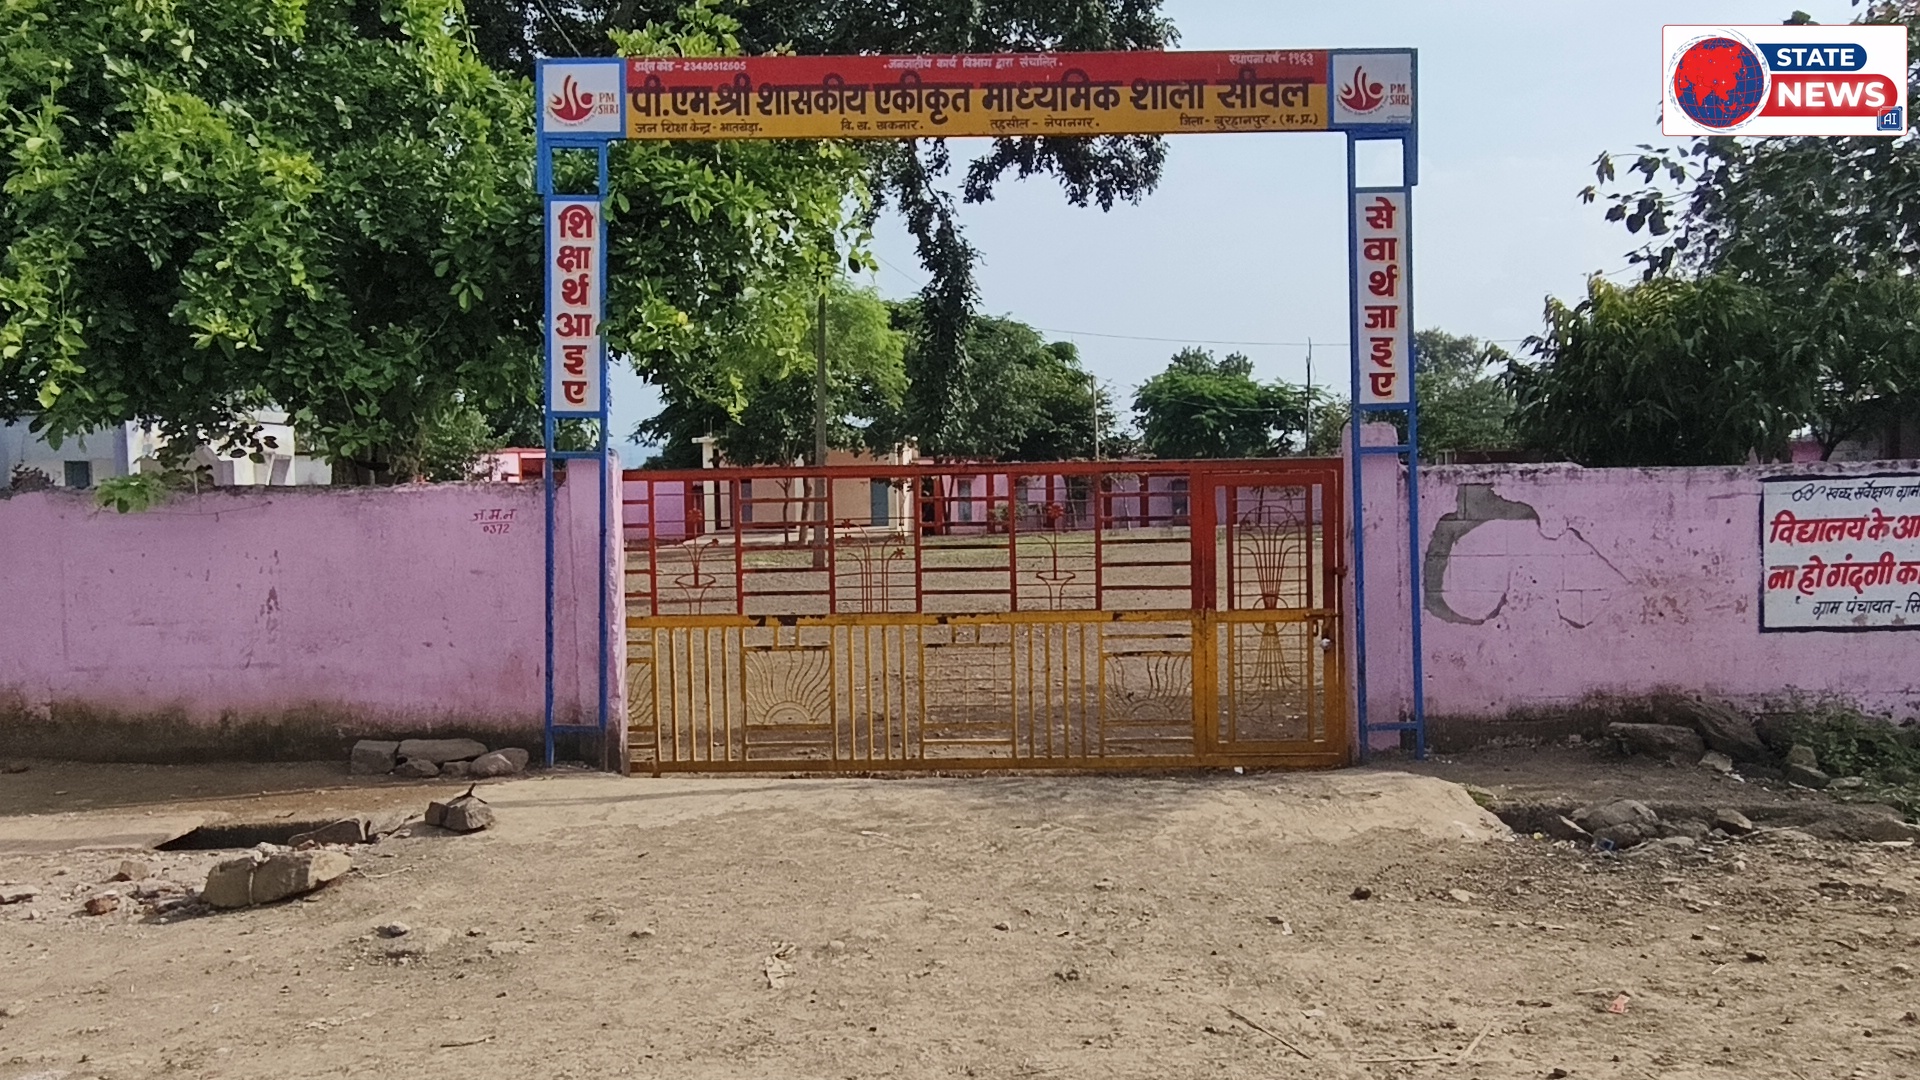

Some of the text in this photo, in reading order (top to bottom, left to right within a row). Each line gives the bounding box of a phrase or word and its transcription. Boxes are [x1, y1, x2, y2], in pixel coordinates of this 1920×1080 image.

[936, 54, 958, 68] कार्य
[962, 55, 992, 68] विभाग
[995, 56, 1014, 69] द्वारा
[1229, 54, 1265, 65] स्थापना
[756, 73, 870, 115] शासकीय
[873, 69, 973, 125] एकीकृत
[980, 68, 1122, 112] माध्यमिक
[1129, 76, 1207, 110] शाला
[1215, 66, 1315, 109] सीवल
[1390, 83, 1406, 94] PM
[598, 92, 615, 103] PM
[1389, 94, 1410, 106] SHRI
[598, 104, 619, 115] SHRI
[635, 123, 657, 133] जन
[660, 119, 688, 134] शिक्षा
[990, 115, 1030, 132] तहसील
[1826, 480, 1920, 503] स्वच्छ सर्वेक्षण ग्राम
[483, 523, 510, 535] 0372
[1769, 507, 1920, 544] विद्यालय के आ
[1768, 565, 1799, 590] ना
[1798, 555, 1828, 595] हो
[1826, 551, 1897, 595] गंदगी
[1812, 601, 1844, 620] ग्राम
[1846, 595, 1895, 614] पंचायत
[1905, 592, 1920, 614] सि
